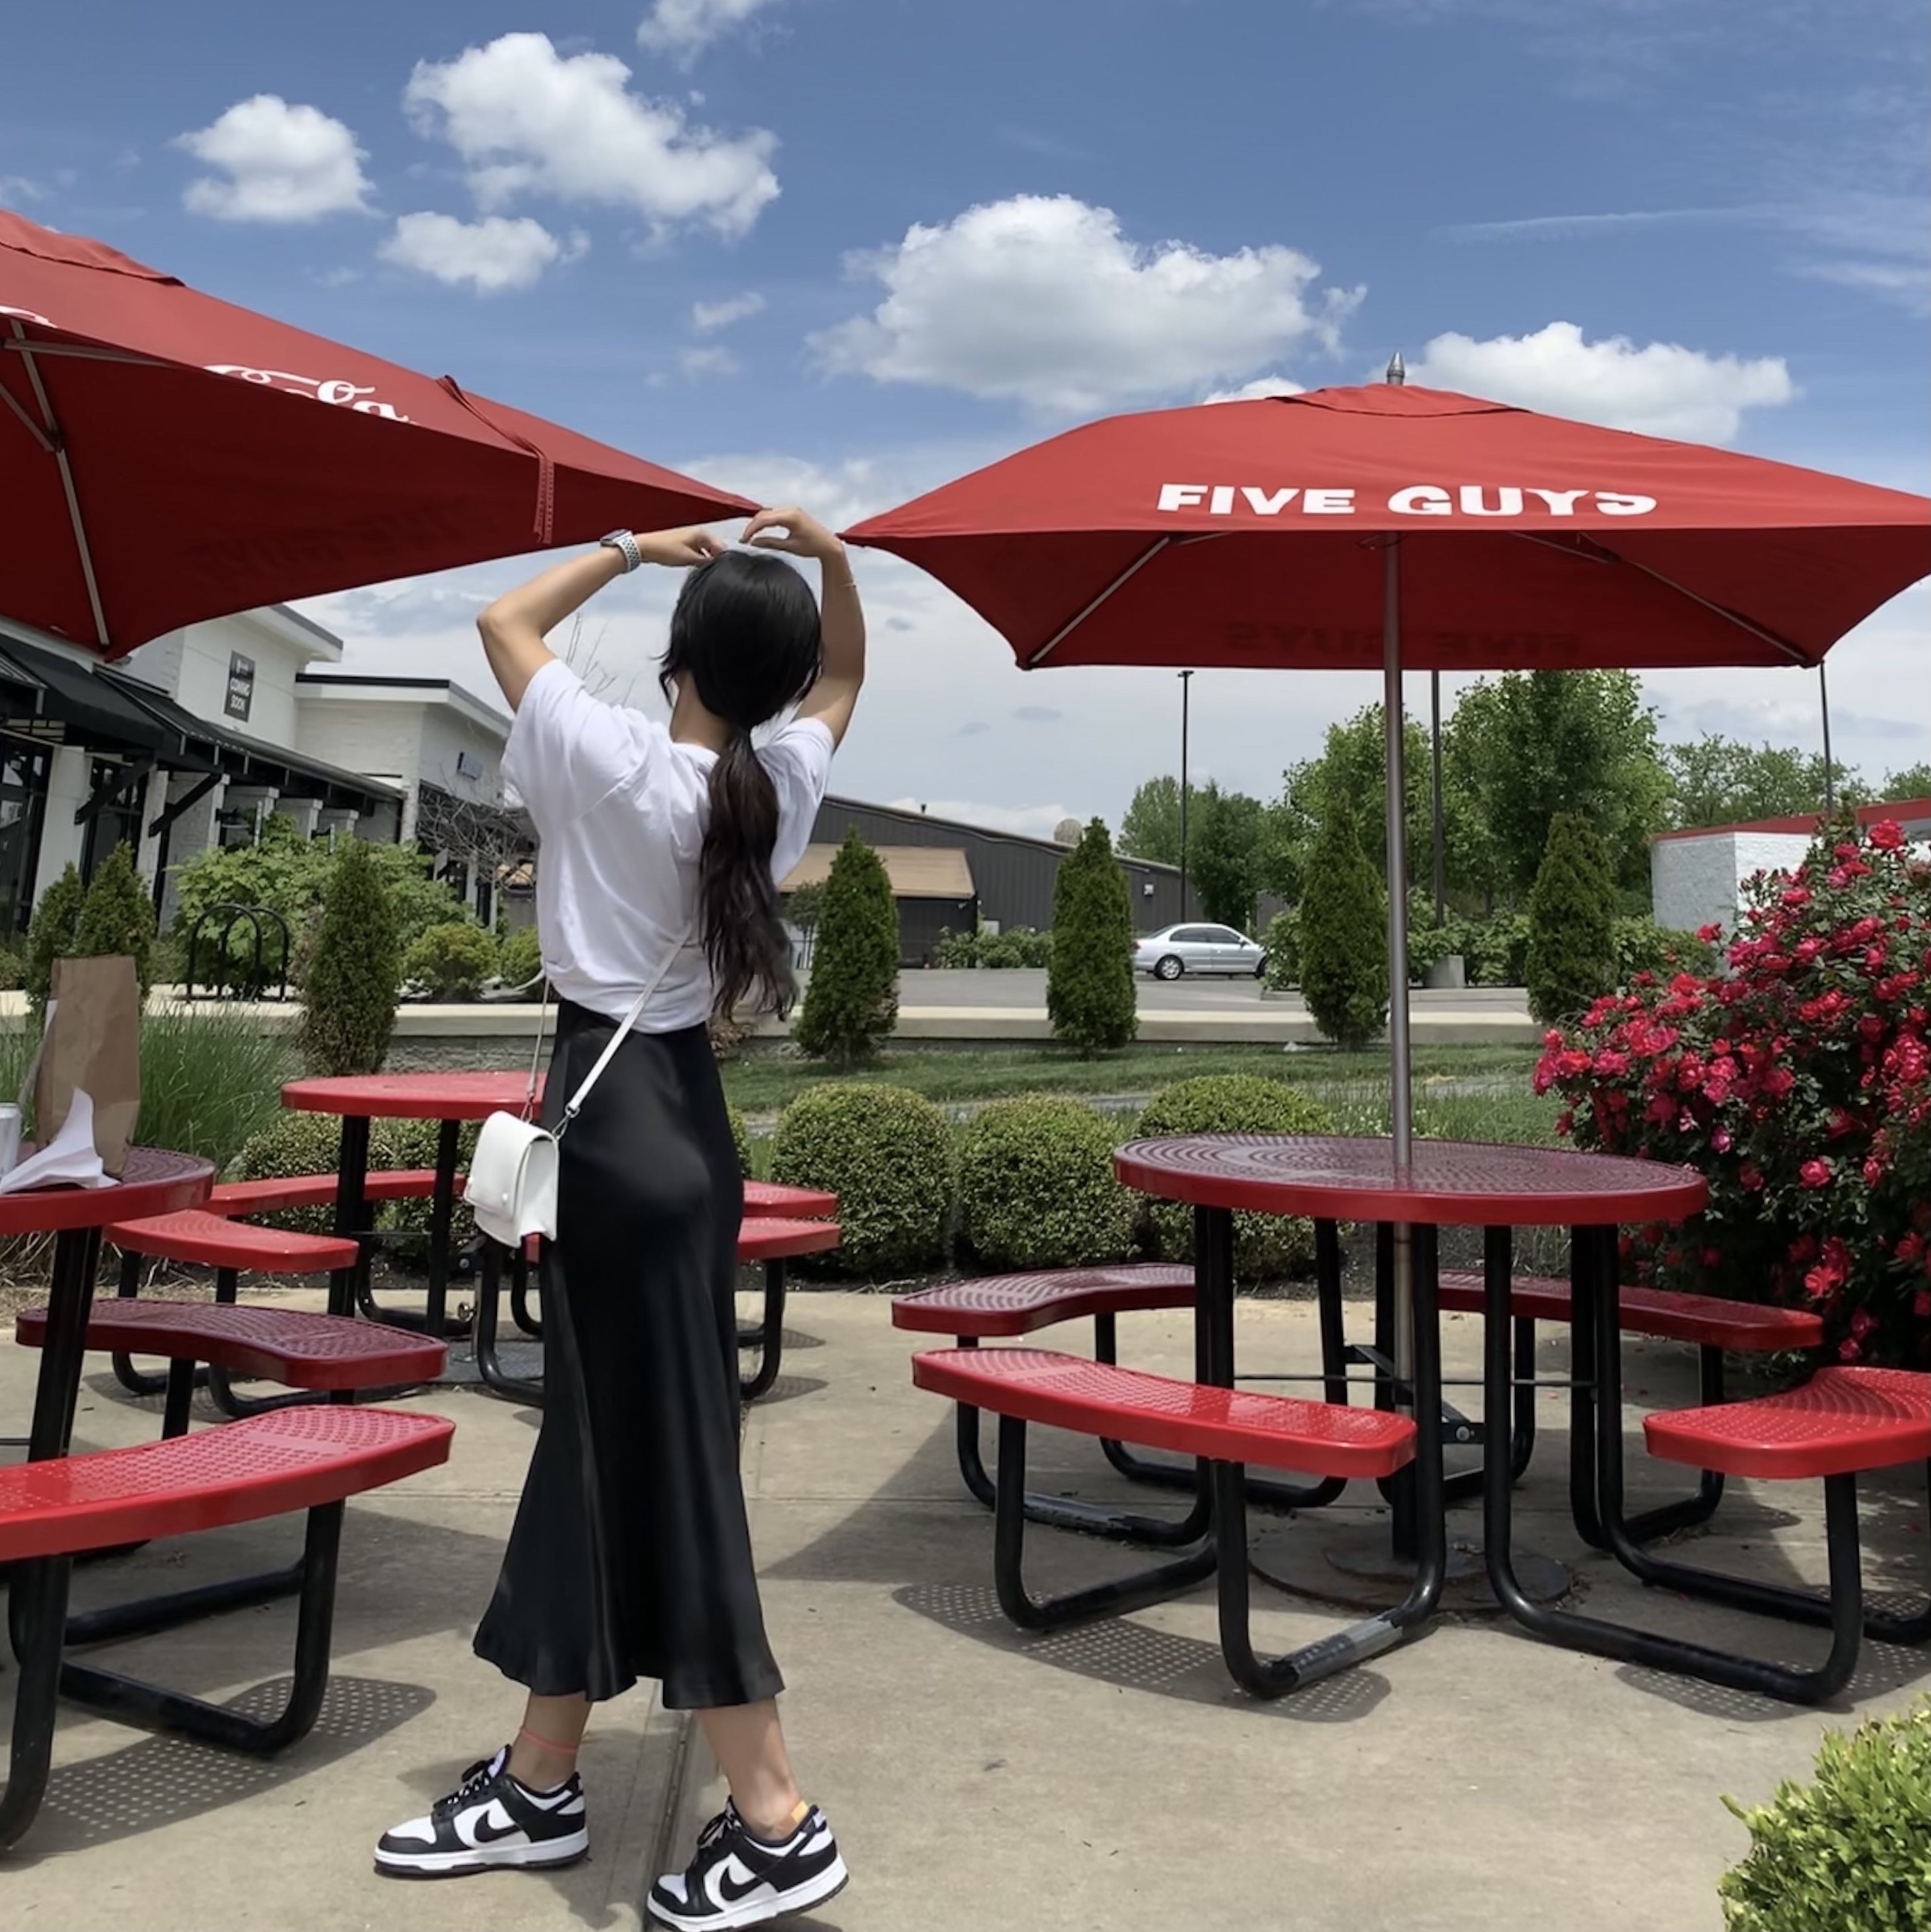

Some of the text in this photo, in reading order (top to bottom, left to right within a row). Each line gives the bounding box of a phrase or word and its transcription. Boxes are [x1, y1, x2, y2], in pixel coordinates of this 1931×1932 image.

[1157, 484, 1657, 516] FIVE GUYS
[230, 676, 250, 697] COMING
[231, 694, 246, 712] SOON
